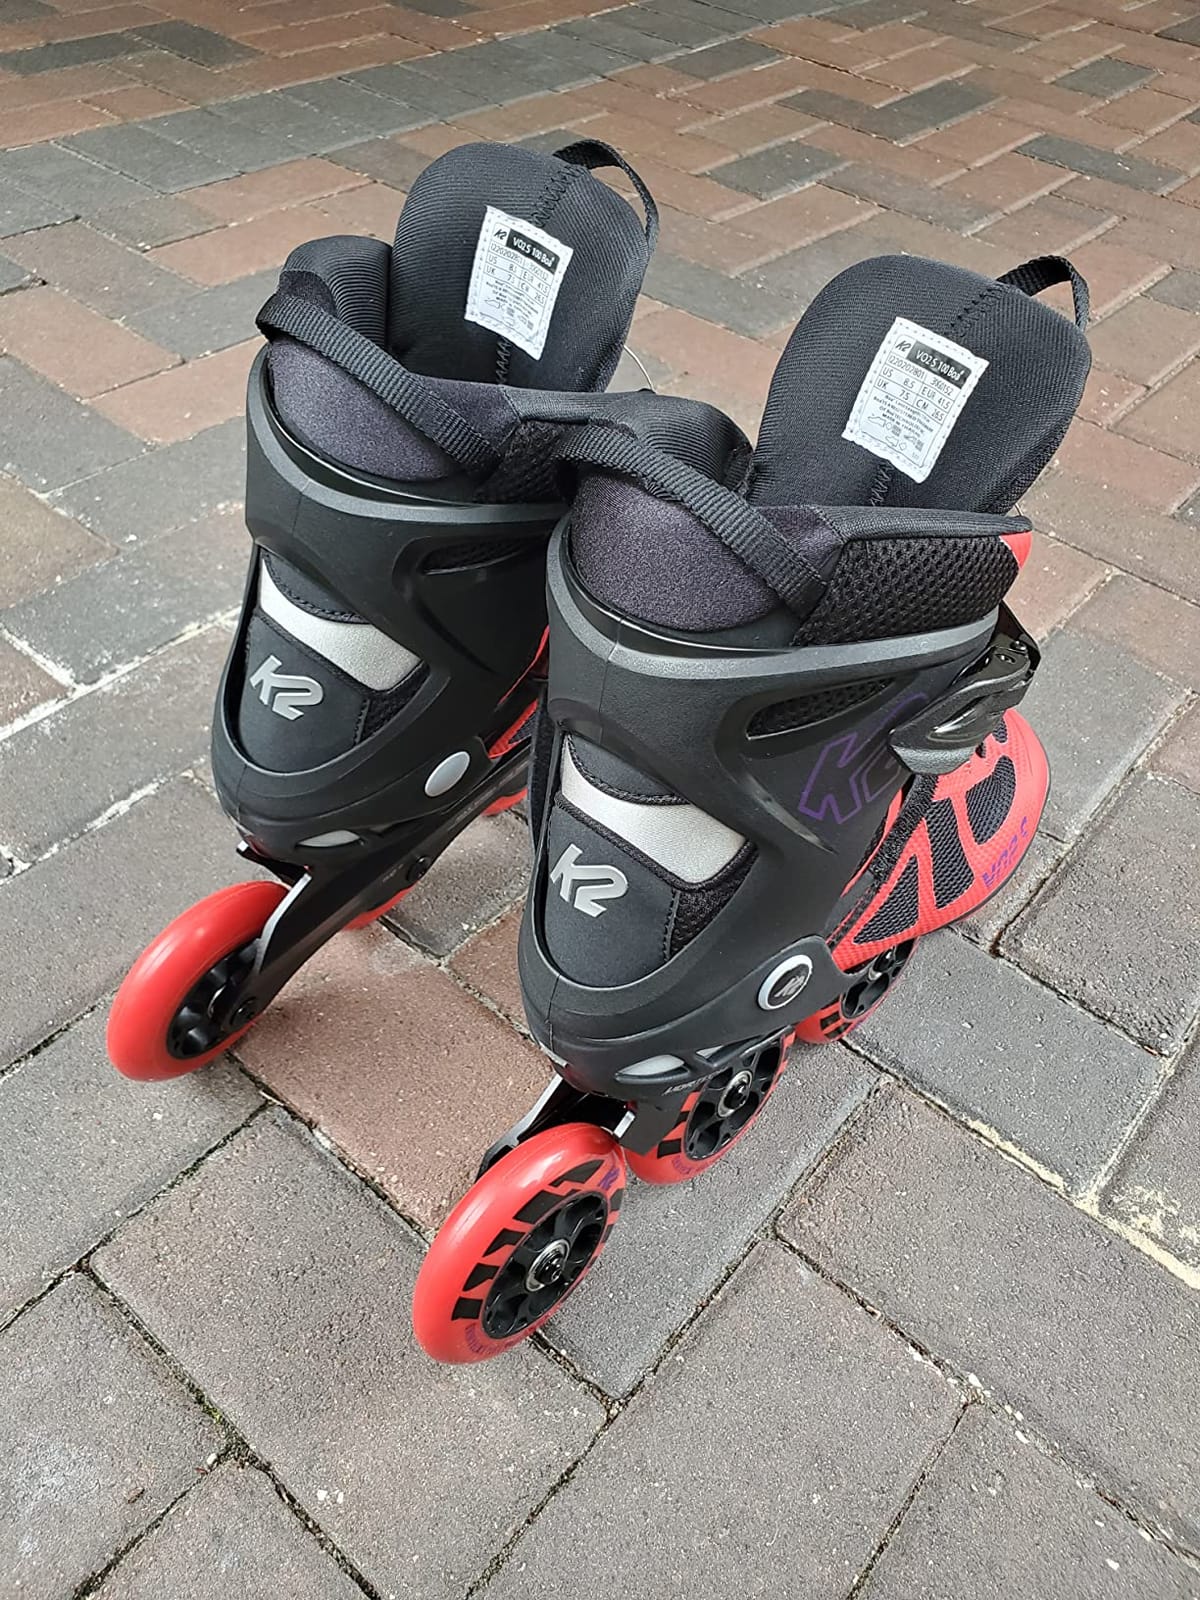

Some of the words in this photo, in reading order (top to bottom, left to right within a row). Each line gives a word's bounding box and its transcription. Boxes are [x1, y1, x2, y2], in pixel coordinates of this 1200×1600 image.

[494, 229, 507, 241] K2
[488, 254, 497, 264] US
[531, 247, 542, 260] 100
[486, 264, 495, 275] UK
[895, 340, 911, 352] K2
[938, 361, 950, 374] 100
[876, 378, 889, 390] UK
[882, 366, 893, 377] US
[902, 377, 915, 389] 8.5
[936, 396, 950, 409] 41.5
[249, 655, 325, 721] K2
[549, 842, 630, 918] K2
